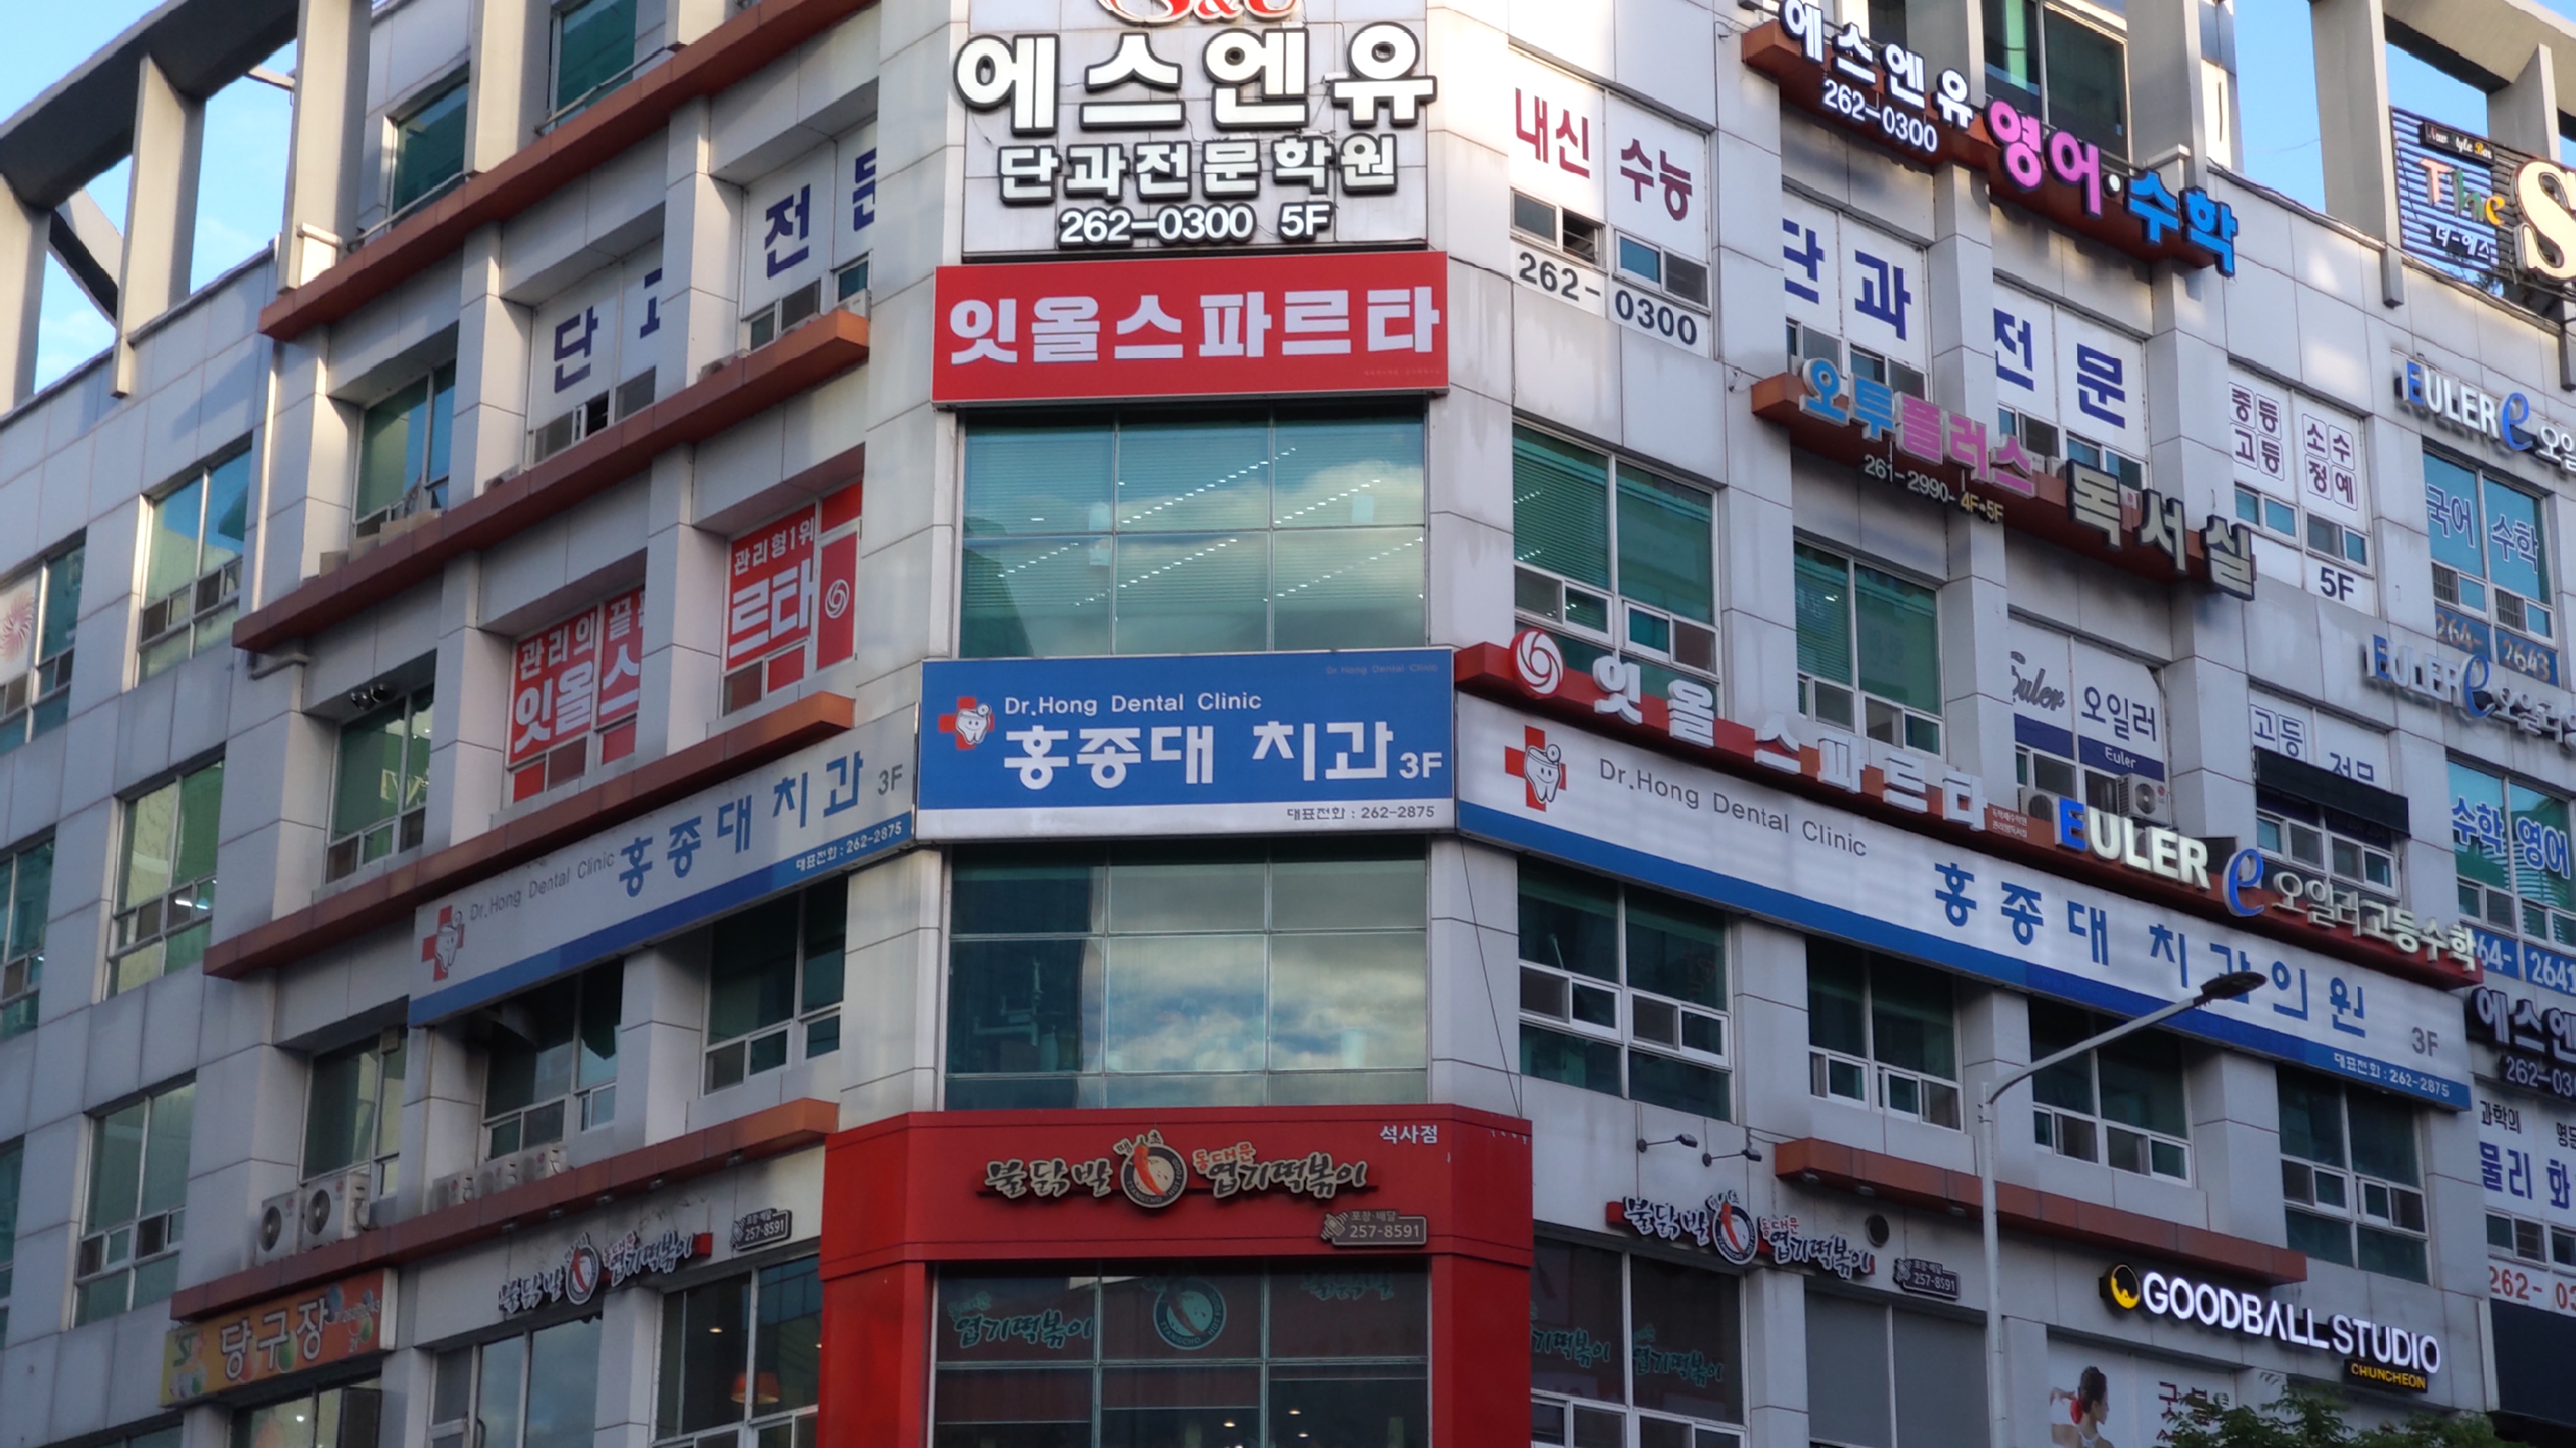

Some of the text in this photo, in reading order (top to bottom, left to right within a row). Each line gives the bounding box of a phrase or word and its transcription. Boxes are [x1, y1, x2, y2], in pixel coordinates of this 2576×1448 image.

[954, 21, 1437, 136] 에스엔유
[1779, 0, 1973, 130] 에스엔유
[1823, 79, 1938, 153] 262-0300
[998, 132, 1398, 204] 단과전문학원
[1515, 87, 1693, 221] 내신 수능
[2475, 141, 2492, 159] Bar
[2419, 157, 2506, 226] The
[1057, 199, 1335, 250] 262-0300 5F
[949, 285, 1440, 366] 잇올스파르타
[1615, 290, 1697, 346] 0300
[1994, 308, 2126, 429] 전문
[2231, 387, 2278, 433] 중등
[2403, 359, 2500, 440] EULER
[2234, 428, 2280, 474] 고등
[2306, 423, 2350, 463] 소수
[1800, 357, 2255, 601] 오투플러스 독서실
[2309, 461, 2354, 505] 정예
[2427, 482, 2539, 574] 국어 수학
[2320, 566, 2354, 601] 5F
[520, 610, 597, 680] 관리의
[2371, 634, 2459, 708] EULER
[1111, 693, 1184, 713] Dental
[1197, 691, 1262, 711] Clinic
[2081, 686, 2157, 742] 오일러
[1003, 720, 1443, 791] 홍종대 치과 3F
[1593, 655, 1987, 832] 잇올스파르타
[2104, 746, 2137, 769] Euler
[2254, 710, 2303, 758] 고등
[528, 866, 570, 899] Dental
[577, 853, 614, 879] Clinic
[619, 793, 752, 898] 홍종대
[772, 750, 864, 829] 치과
[877, 764, 903, 796] 3F
[1286, 806, 1345, 822] 대표전화
[1360, 805, 1435, 820] 262-2875
[2451, 795, 2504, 855] 수학
[2516, 816, 2571, 880] 영어
[796, 845, 837, 871] 대표전화
[846, 821, 902, 854] 262-2875
[2056, 796, 2211, 890] EULER
[2272, 871, 2477, 972] 오일러고등수학
[1713, 792, 1789, 834] Dental
[1802, 820, 1868, 858] Clinic
[1935, 862, 2109, 966] 홍종대
[2411, 1026, 2438, 1057] 3F
[2334, 1052, 2380, 1079] 대표전화
[2389, 1069, 2450, 1097] 262-2875
[1380, 1125, 1438, 1144] 석사점
[2480, 1100, 2521, 1134] 과학의
[985, 1141, 1368, 1199] 불닭발 동대문 엽기떡볶이
[2480, 1141, 2532, 1200] 물리
[745, 1219, 784, 1241] 257-8591
[1349, 1225, 1420, 1239] 257-8591
[1623, 1196, 1710, 1247] 불닭발
[1769, 1230, 1870, 1279] 엽기떡볶이
[500, 1266, 566, 1314] 불닭발
[608, 1230, 694, 1287] 엽기떡볶이
[1914, 1272, 1956, 1292] 257-8591
[221, 1297, 330, 1381] 당구장
[955, 1308, 1093, 1349] 엽기떡볶이
[1531, 1326, 1611, 1368] 기떡볶이
[2143, 1272, 2441, 1373] GOODBALL STUDIO
[2350, 1363, 2426, 1390] CHUNCHEON
